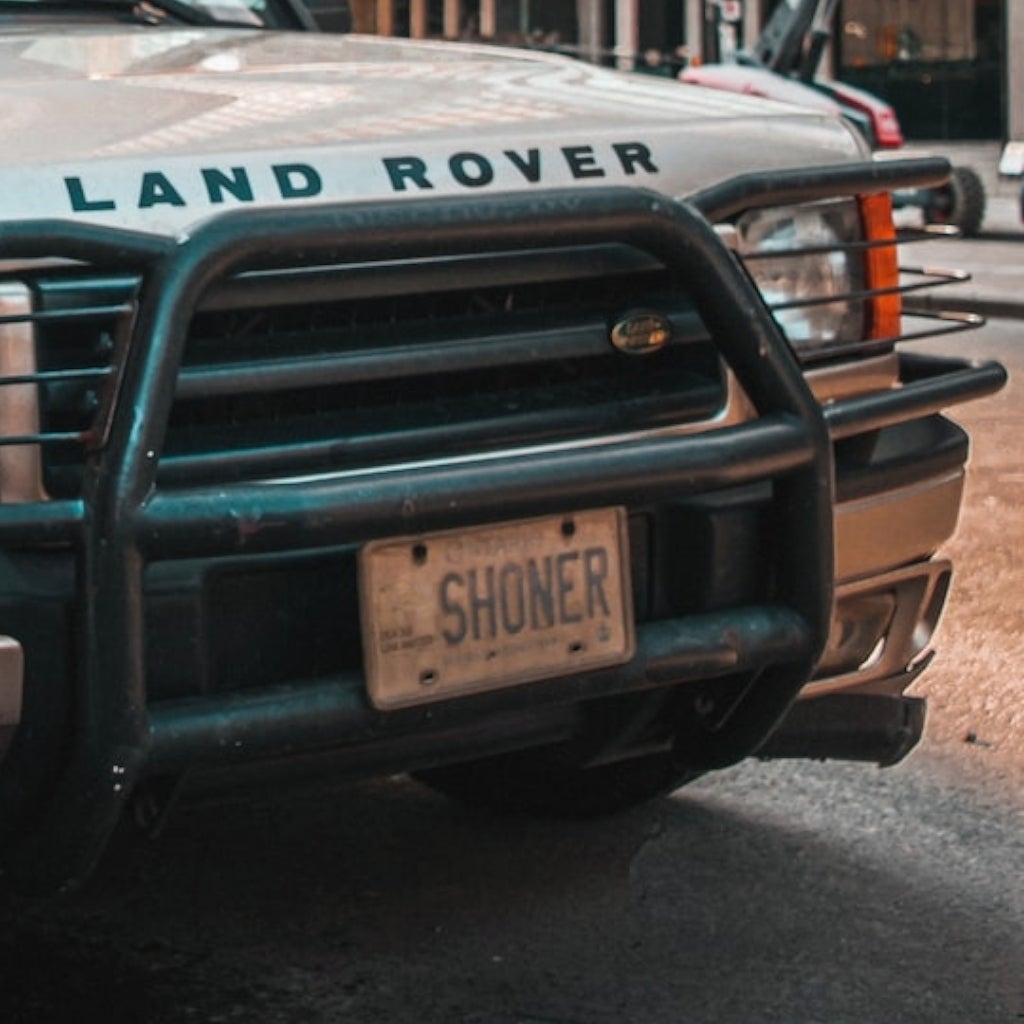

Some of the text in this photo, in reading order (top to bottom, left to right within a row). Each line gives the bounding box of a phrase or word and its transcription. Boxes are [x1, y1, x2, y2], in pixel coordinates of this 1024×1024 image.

[63, 141, 659, 212] LAND ROVER
[439, 546, 610, 647] SHONER
